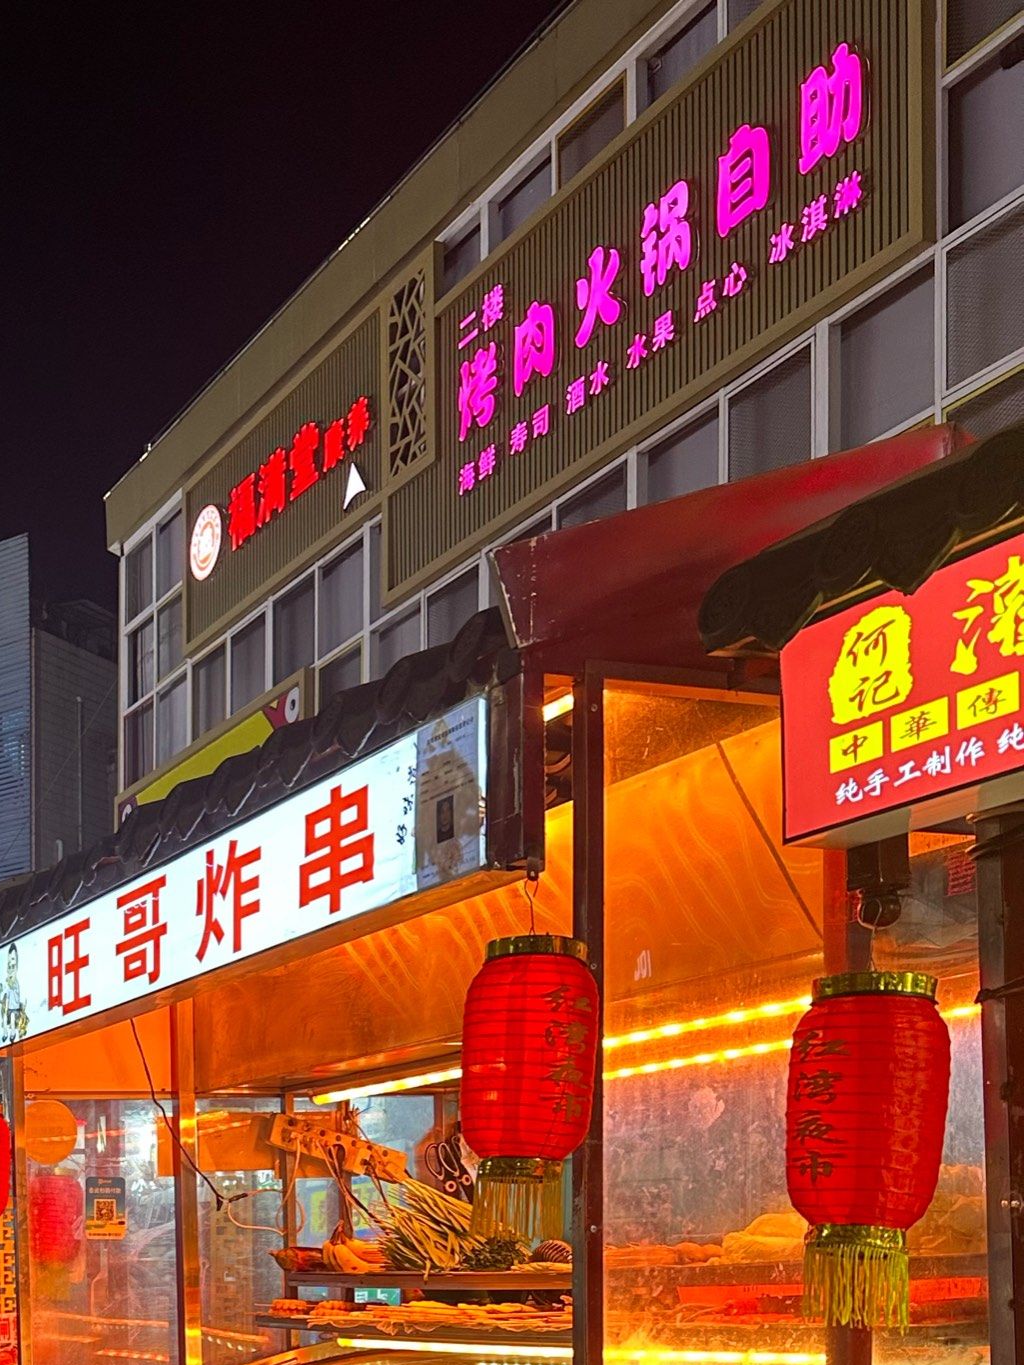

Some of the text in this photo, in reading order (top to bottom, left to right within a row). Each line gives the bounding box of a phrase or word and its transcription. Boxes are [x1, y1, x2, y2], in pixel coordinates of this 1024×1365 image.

[458, 42, 863, 442] 烤肉火锅自助
[458, 283, 505, 350] 二楼
[458, 170, 862, 496] 海鲜 寿司 酒水 水果 点心 冰淇淋
[846, 619, 900, 712] 何记
[835, 737, 985, 806] 纯手工制作
[47, 784, 375, 1016] 旺哥炸串
